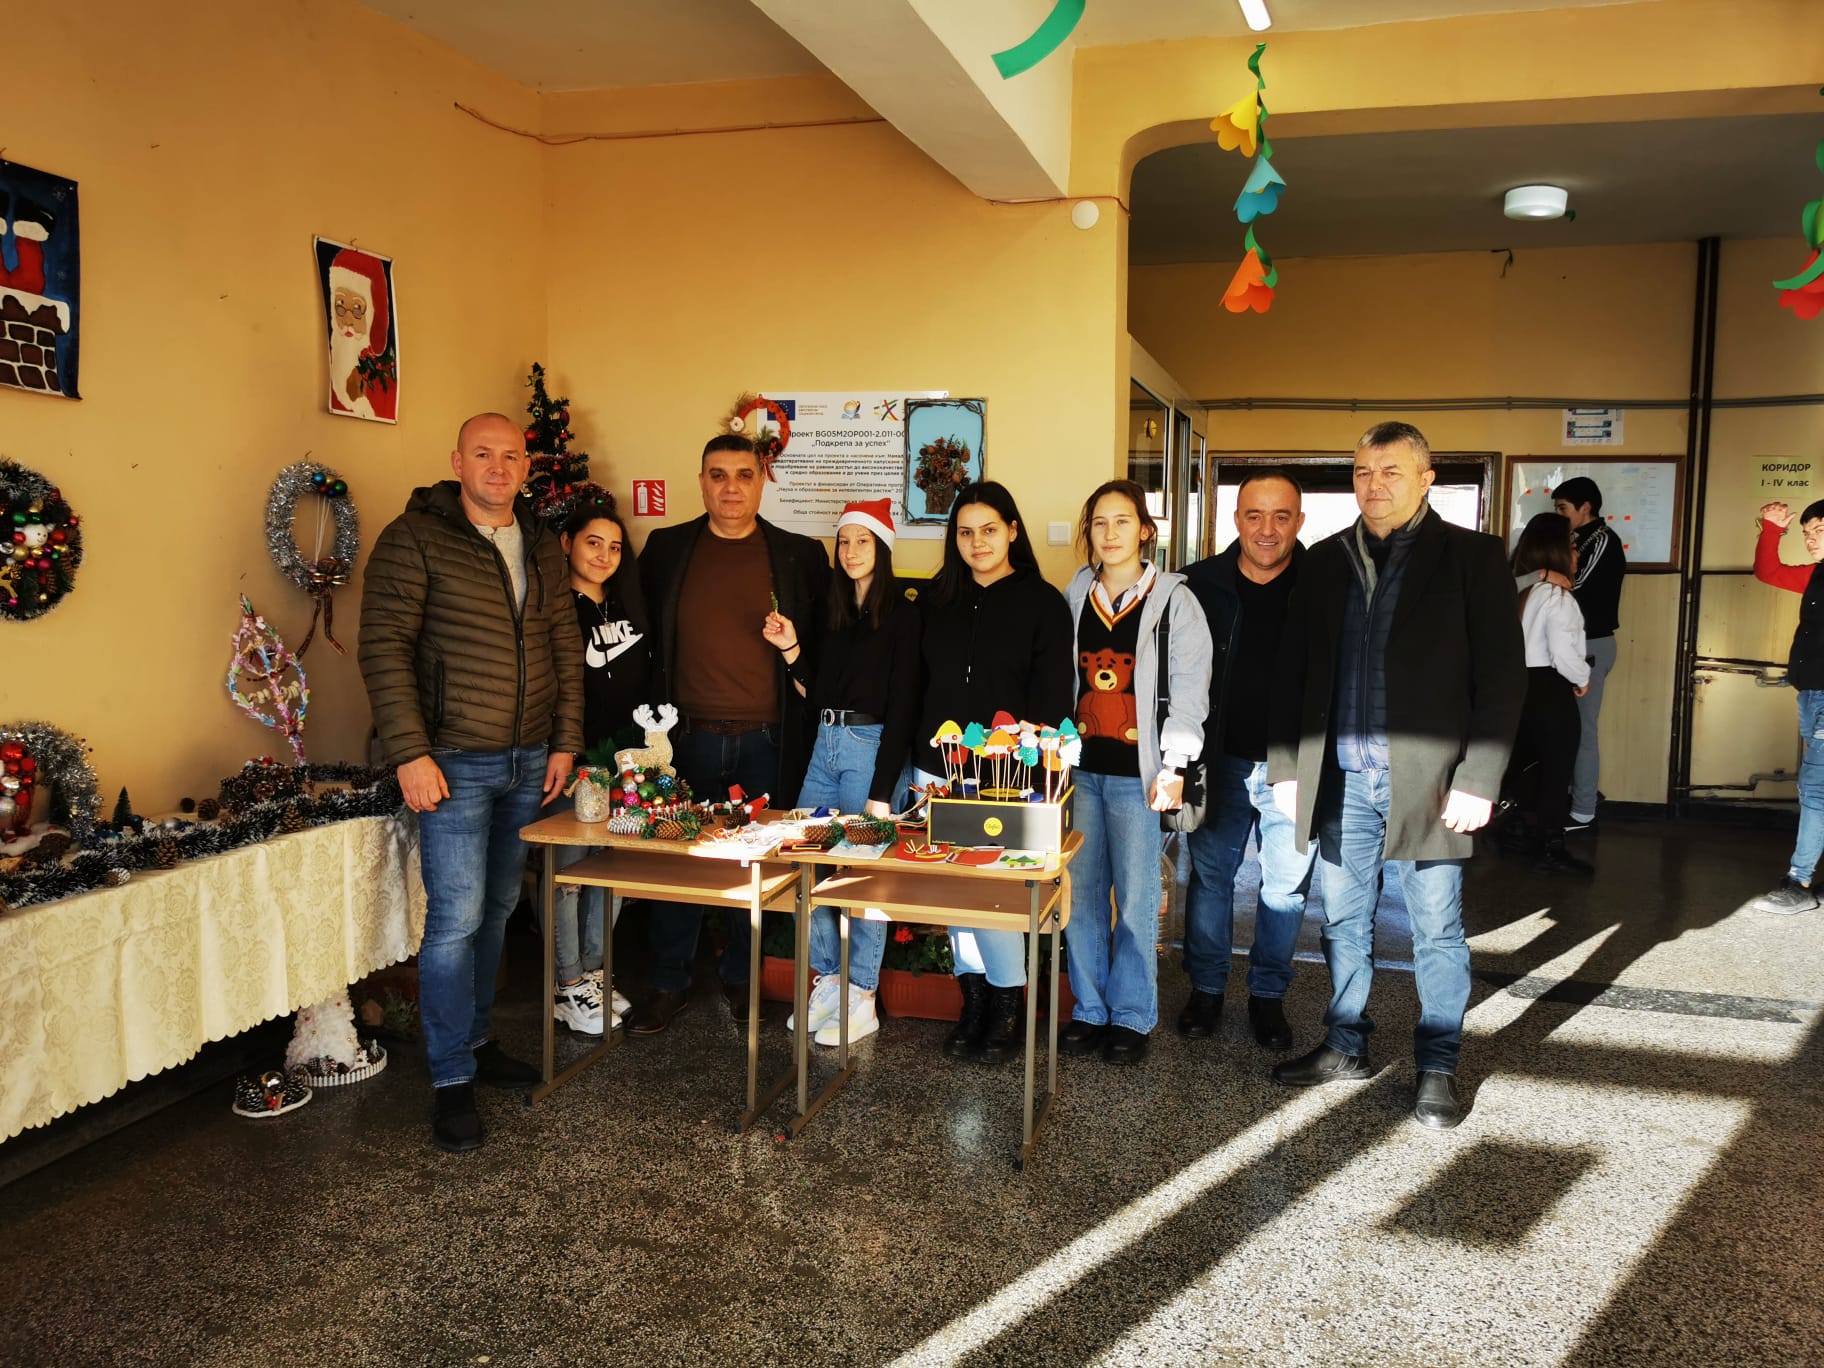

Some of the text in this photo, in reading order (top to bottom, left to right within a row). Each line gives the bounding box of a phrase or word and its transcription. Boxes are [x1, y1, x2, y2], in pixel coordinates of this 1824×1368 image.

[1761, 463, 1811, 472] КОРИДОР
[1773, 479, 1783, 487] IV
[591, 620, 636, 645] NIKE
